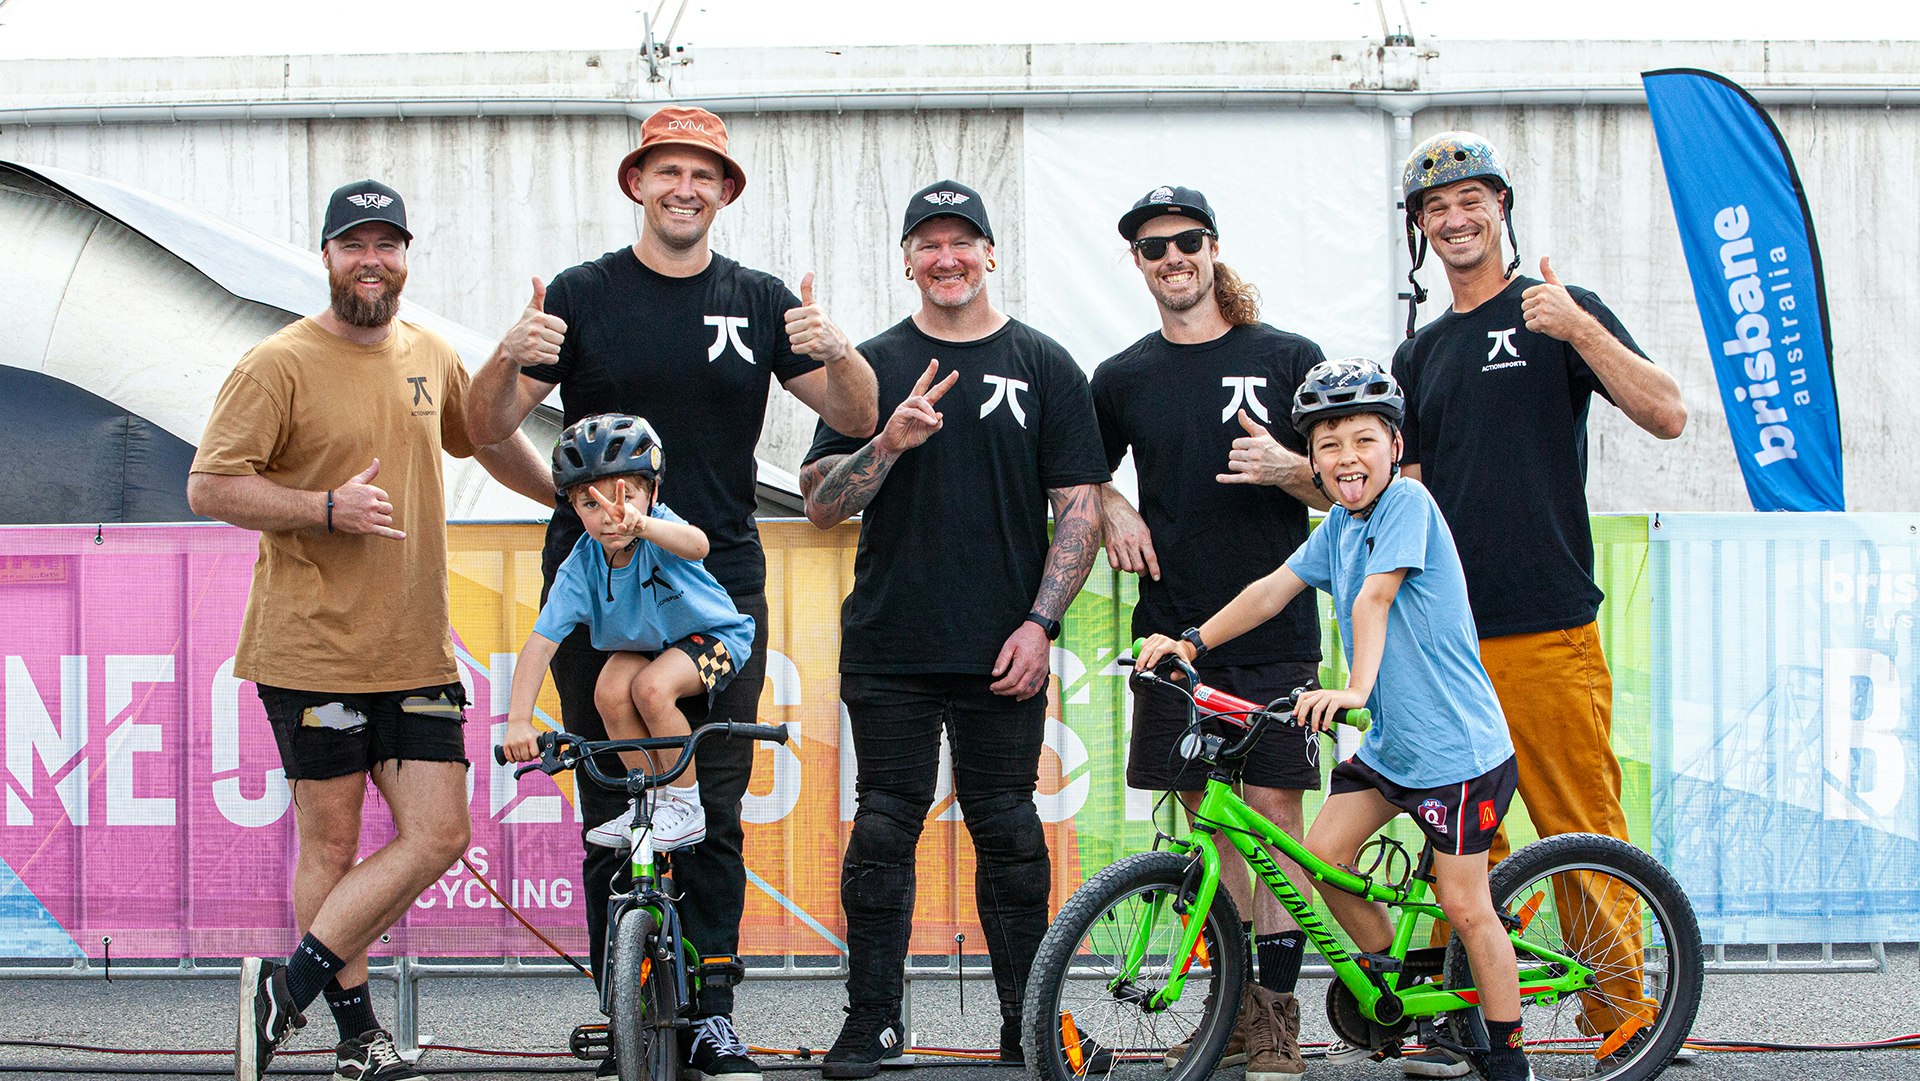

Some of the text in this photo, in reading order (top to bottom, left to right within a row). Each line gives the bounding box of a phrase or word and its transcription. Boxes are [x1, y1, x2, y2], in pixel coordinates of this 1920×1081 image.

[1482, 360, 1527, 372] ACTIONSPORTS
[1714, 204, 1798, 467] brisbane
[1769, 246, 1811, 406] australia
[1823, 559, 1919, 604] bris
[5, 655, 176, 827] NE
[1425, 809, 1440, 825] Q
[414, 878, 574, 909] CYCLING
[1241, 847, 1351, 963] SPECIALIZED
